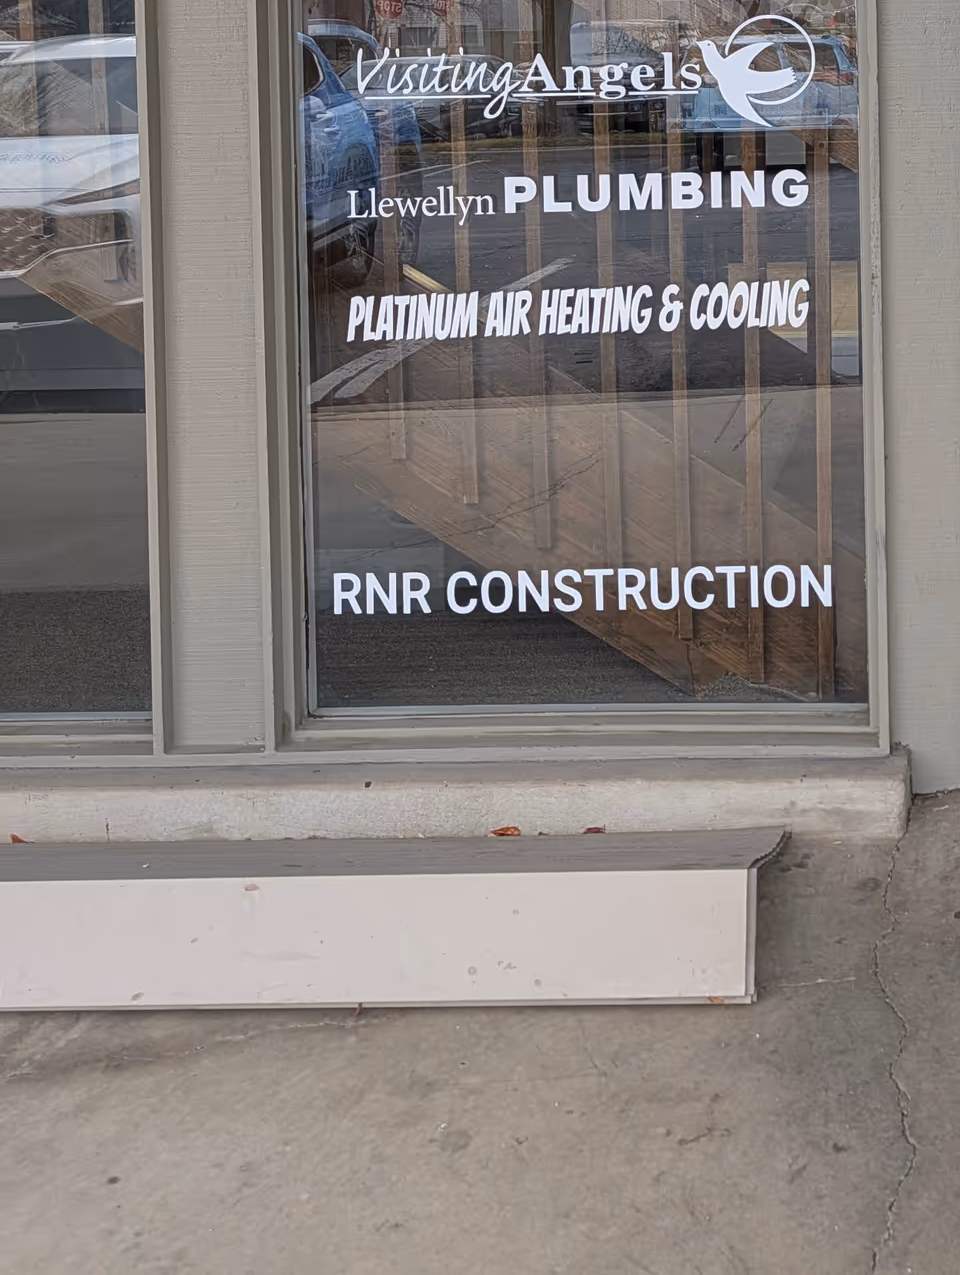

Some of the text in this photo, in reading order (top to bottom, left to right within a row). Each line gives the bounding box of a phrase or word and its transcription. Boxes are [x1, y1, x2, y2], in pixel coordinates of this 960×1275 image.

[346, 169, 810, 226] Llewellyn PLUMBING
[346, 279, 811, 342] PLATINUM AIR HEATING & COOLING
[332, 564, 834, 615] RNR CONSTRUCTION
